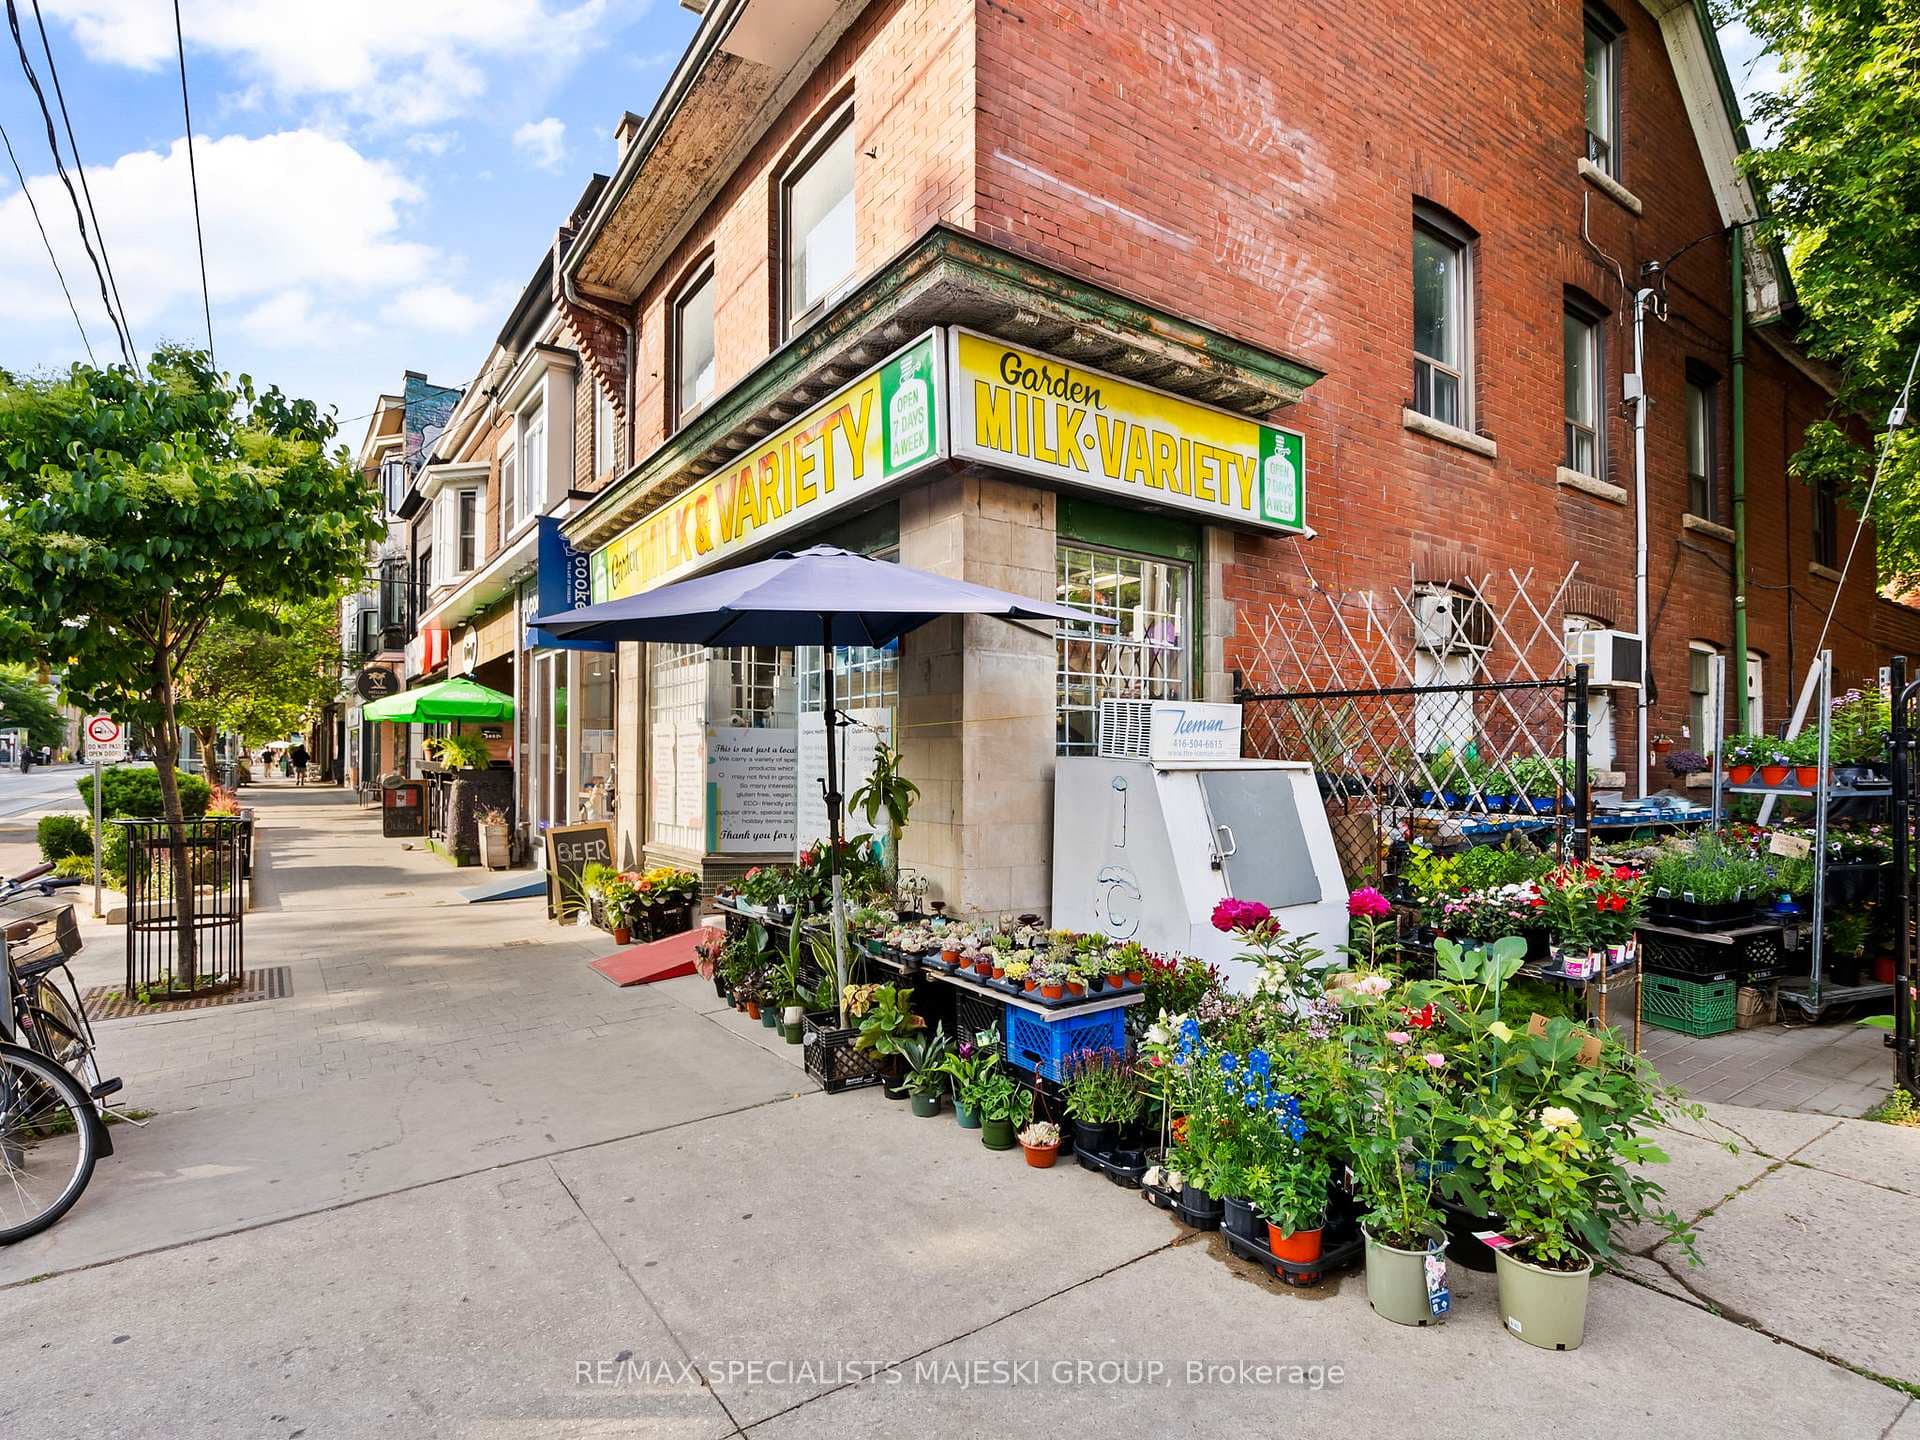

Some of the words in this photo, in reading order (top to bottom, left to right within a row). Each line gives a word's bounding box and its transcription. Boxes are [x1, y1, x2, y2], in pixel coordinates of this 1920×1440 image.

[1000, 351, 1107, 411] Garden
[897, 387, 919, 413] OPEN
[901, 406, 925, 433] DAYS
[901, 431, 925, 456] WEEK
[696, 494, 714, 556] &
[715, 387, 873, 545] VARIETY
[1271, 462, 1289, 478] OPEN
[1273, 501, 1294, 516] WEEK
[1156, 709, 1240, 735] Iceman
[715, 744, 731, 753] This
[733, 745, 740, 753] is
[742, 745, 754, 753] not
[756, 746, 771, 755] just
[1173, 739, 1223, 749] 416-504-6615
[720, 830, 750, 840] Thank
[753, 832, 771, 841] you
[773, 830, 787, 841] for
[557, 839, 610, 863] BEER
